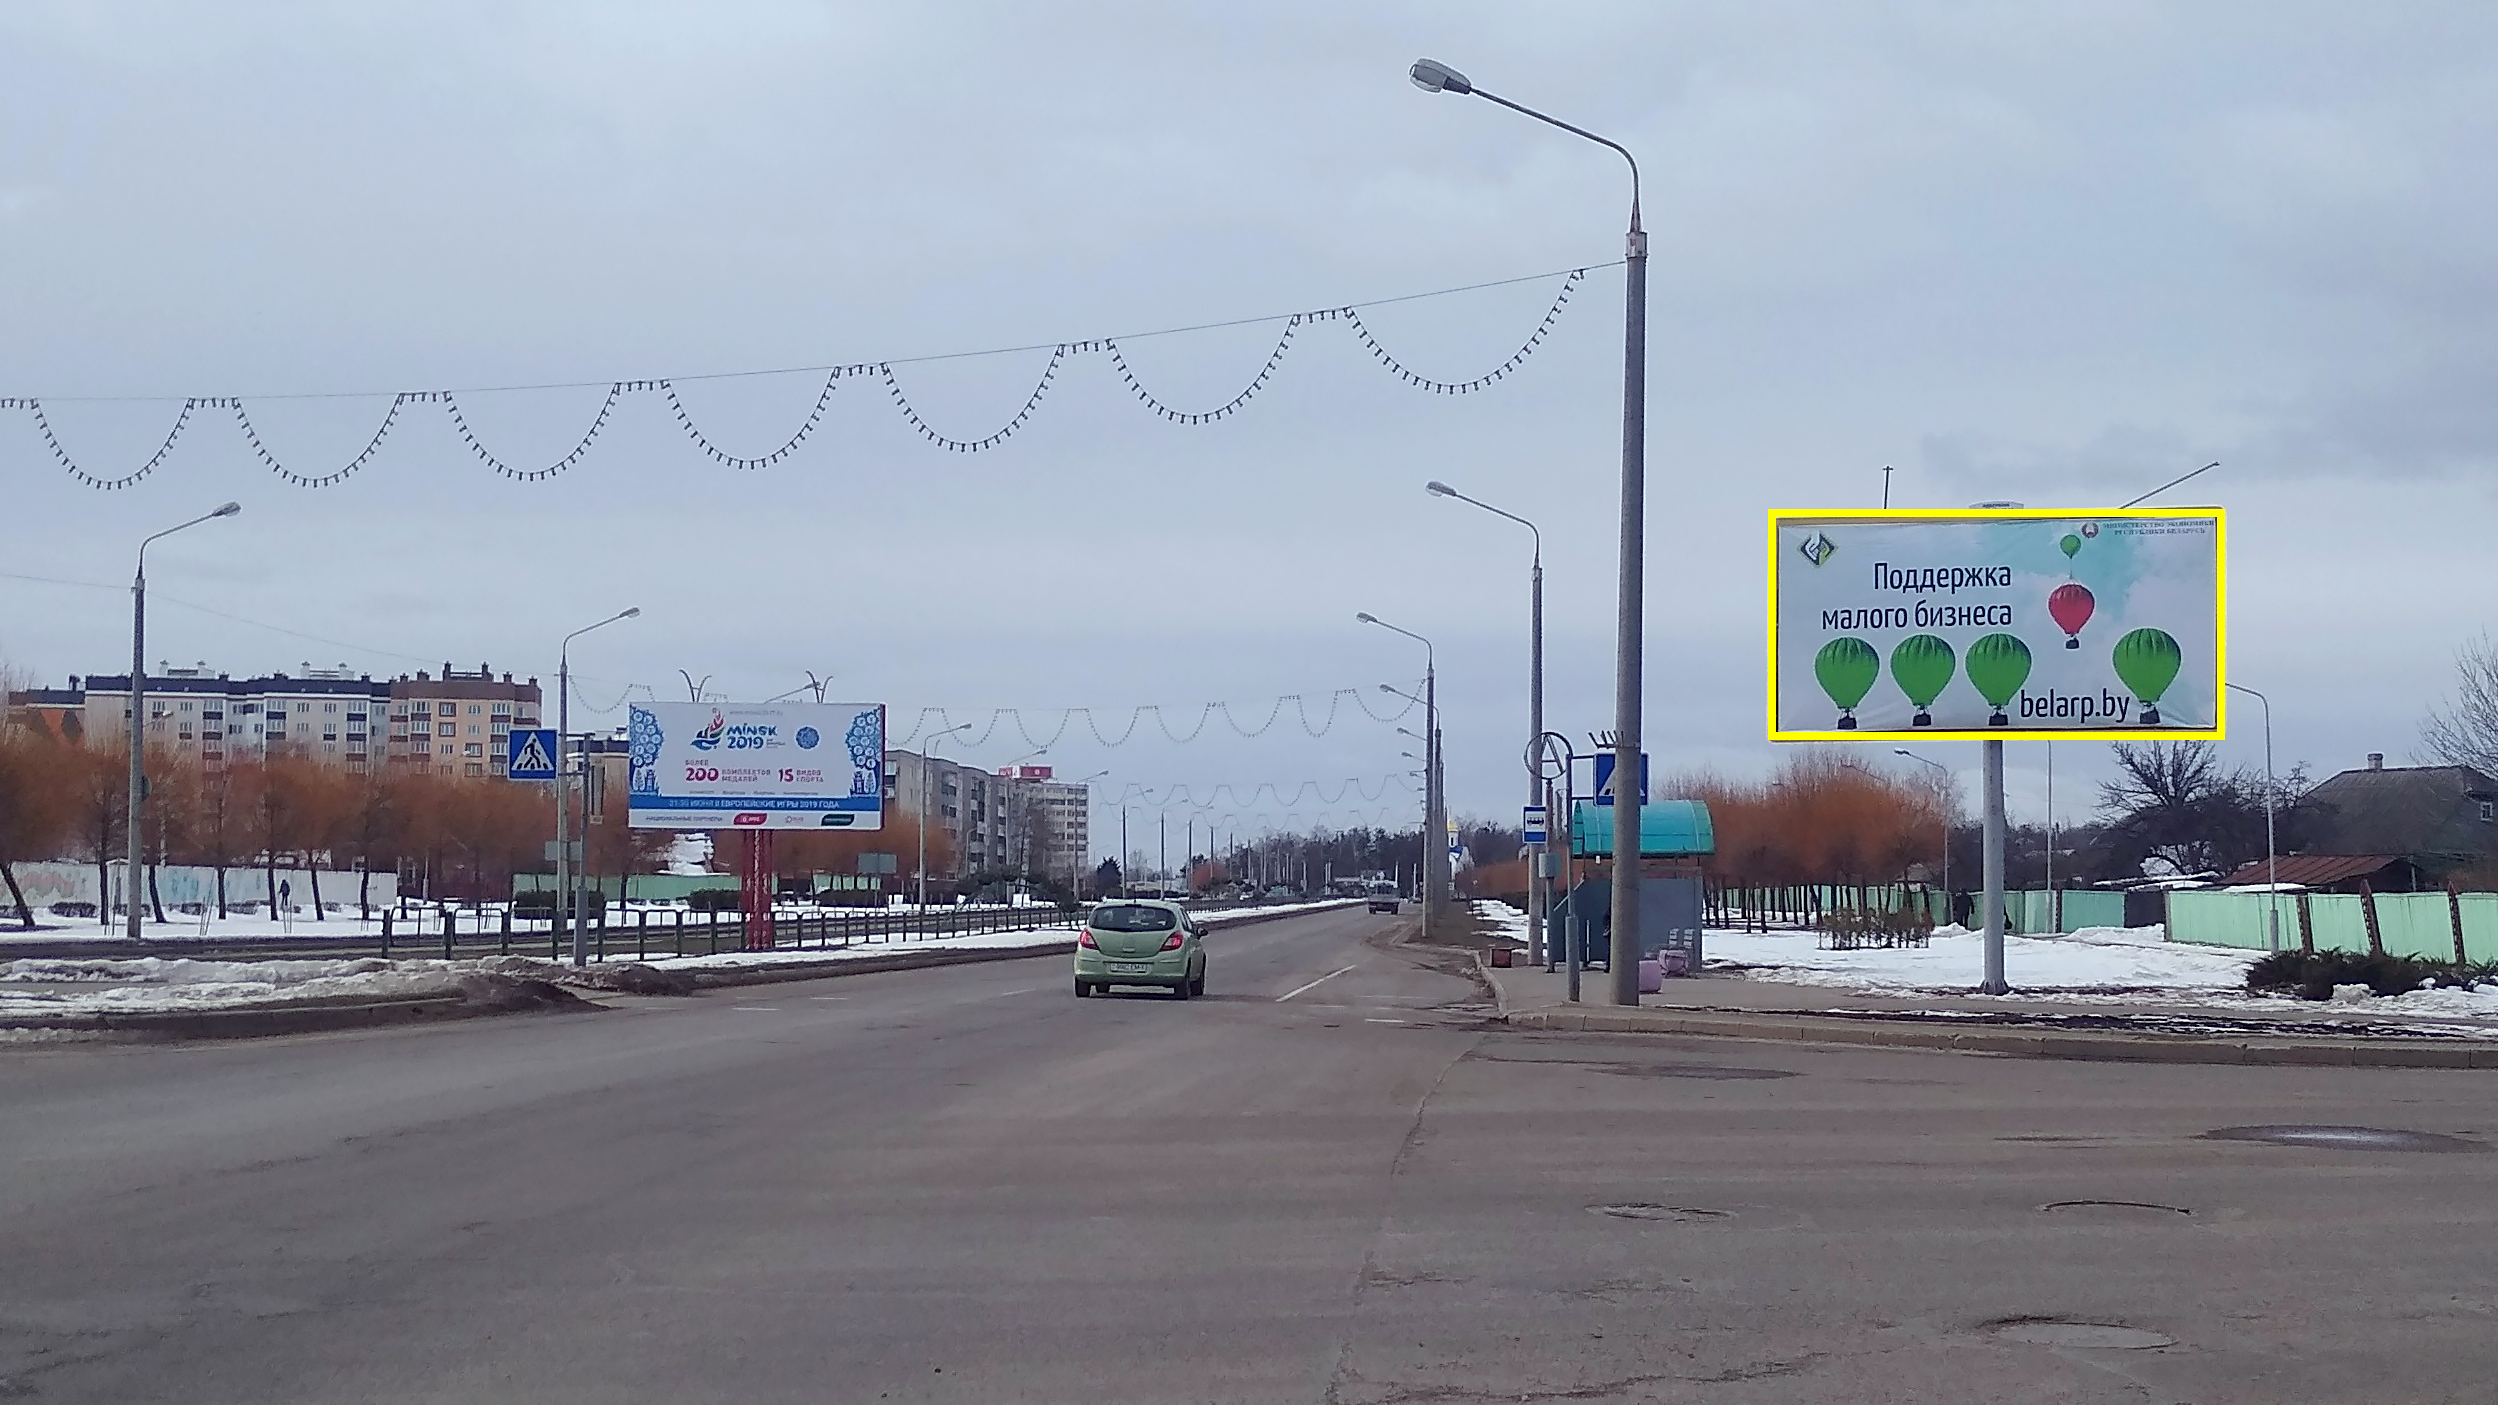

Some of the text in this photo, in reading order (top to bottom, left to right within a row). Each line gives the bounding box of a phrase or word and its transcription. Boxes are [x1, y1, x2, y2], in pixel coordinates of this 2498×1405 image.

[1874, 562, 2011, 594] Поддержка
[1822, 599, 2012, 630] малого бизнеса
[2020, 687, 2130, 723] belarp.by
[727, 736, 764, 749] 2019
[685, 767, 719, 782] 200
[778, 768, 794, 783] 15
[776, 801, 799, 809] ИГРЫ
